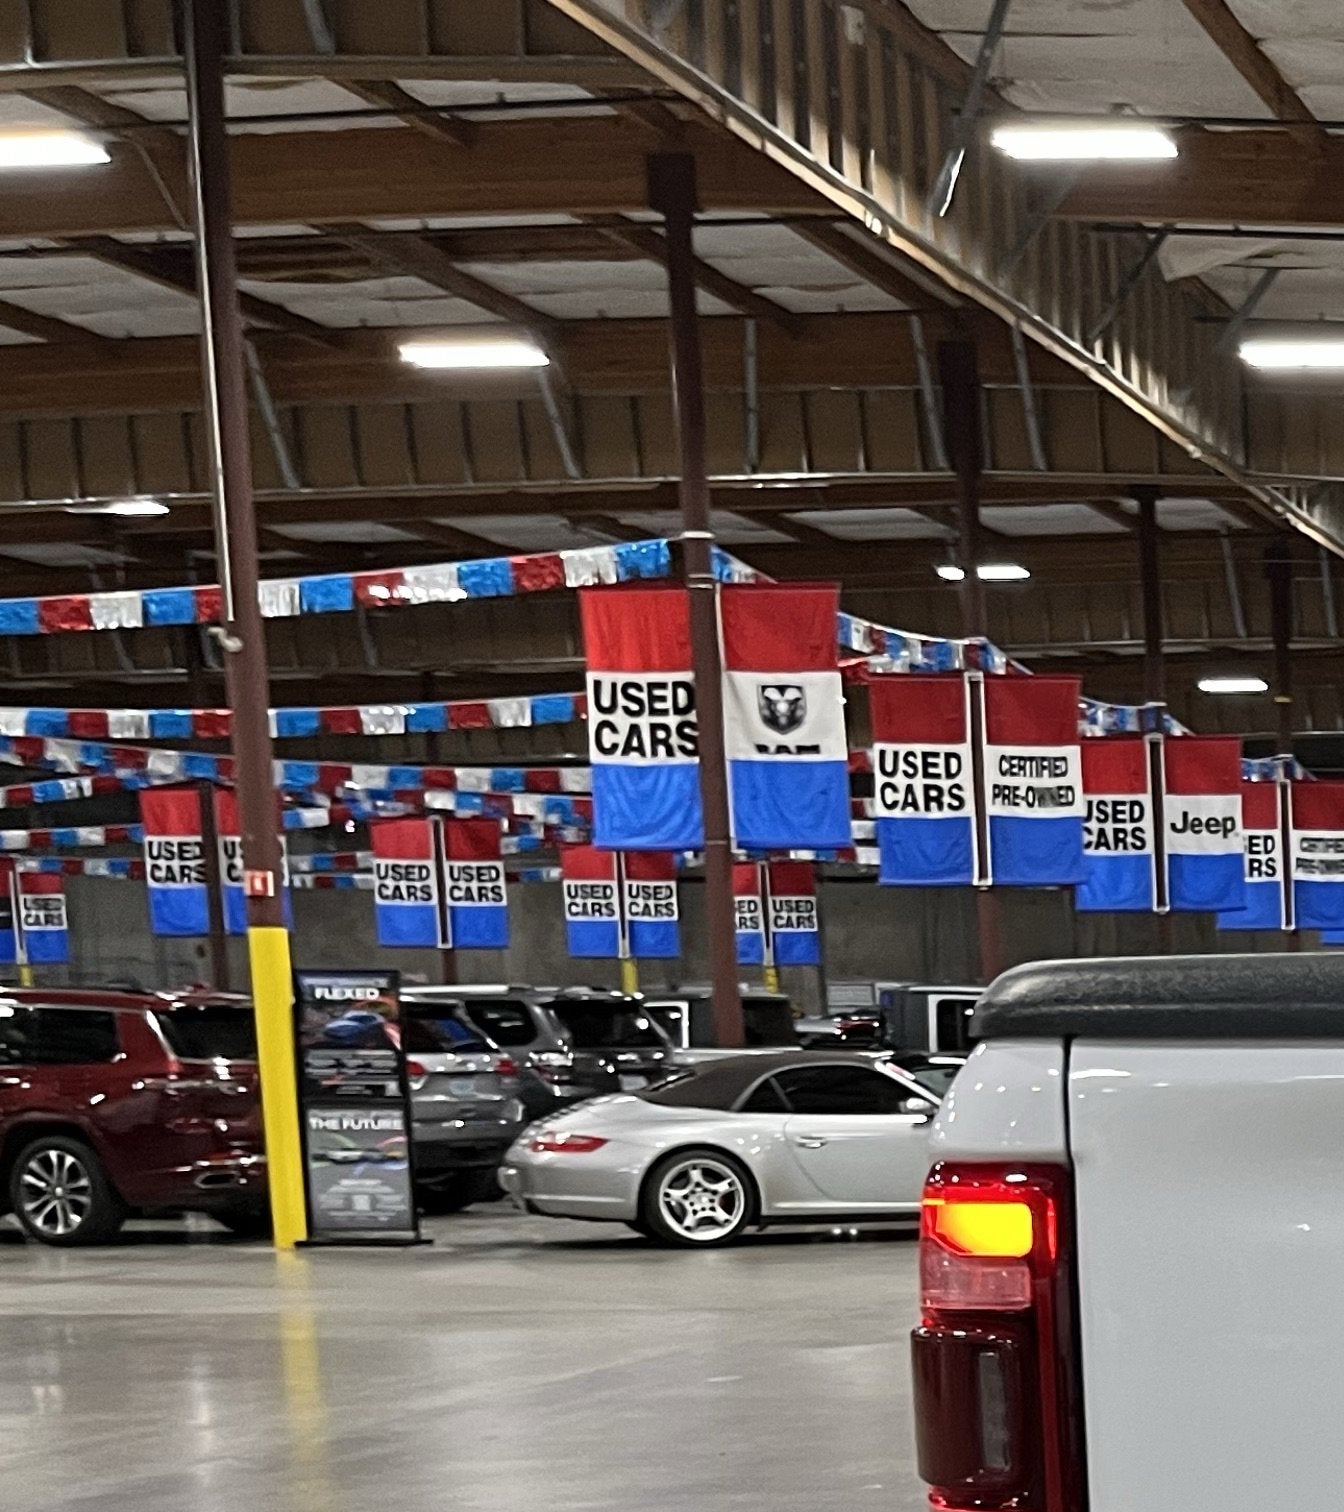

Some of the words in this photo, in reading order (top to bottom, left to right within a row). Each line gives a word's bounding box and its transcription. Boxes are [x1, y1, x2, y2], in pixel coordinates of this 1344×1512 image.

[593, 680, 695, 717] USED
[594, 720, 699, 757] CARS
[879, 749, 962, 780] USED
[999, 754, 1068, 778] CERTIFIED
[880, 782, 965, 812] CARS
[992, 783, 1075, 808] PRE-OED
[1170, 811, 1236, 839] Jeep
[149, 840, 204, 861] USED
[1247, 835, 1276, 855] ED
[150, 863, 207, 884] CARS
[376, 863, 431, 882] USED
[449, 864, 500, 883] USED
[1248, 857, 1277, 878] RS
[377, 884, 433, 902] CARS
[449, 885, 503, 903] CARS
[567, 884, 614, 900] USED
[627, 883, 674, 900] USED
[567, 902, 616, 918] CARS
[628, 902, 675, 918] CARS
[737, 899, 758, 914] ED
[772, 899, 814, 913] USED
[738, 916, 760, 930] RS
[773, 915, 815, 929] CARS
